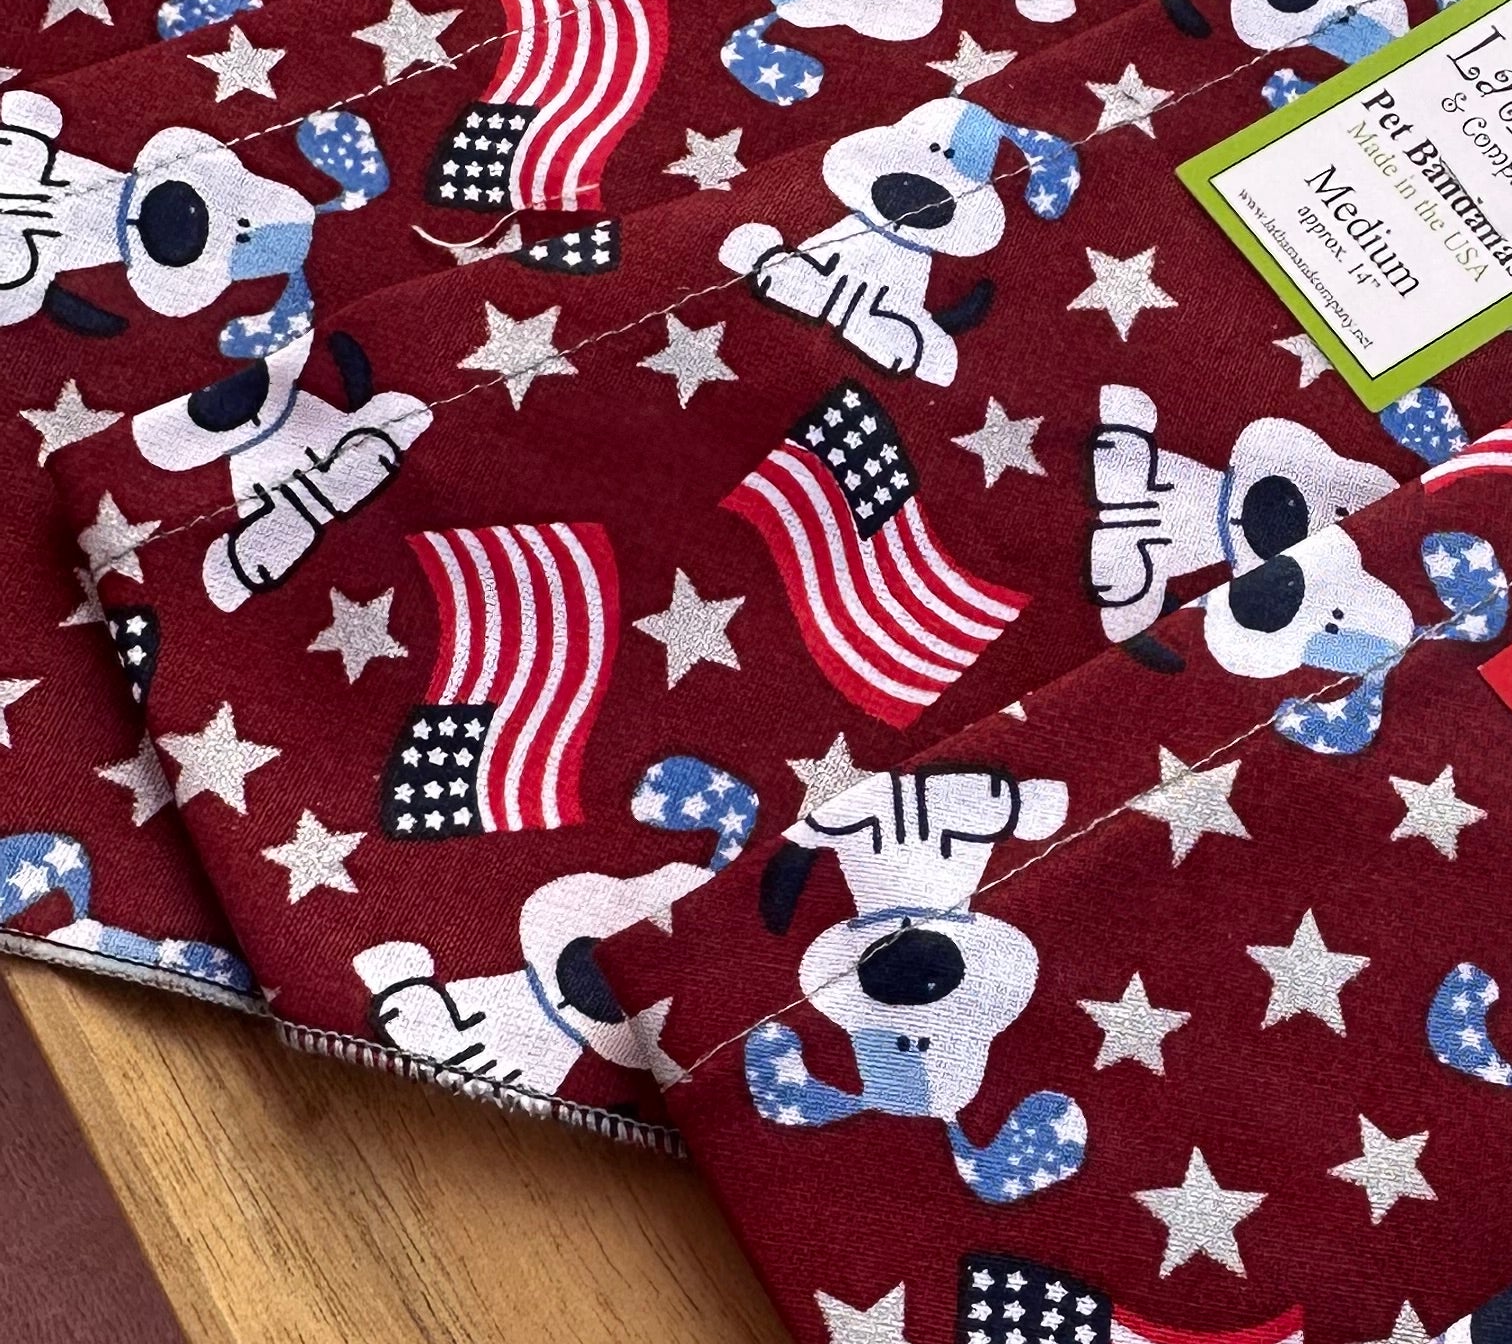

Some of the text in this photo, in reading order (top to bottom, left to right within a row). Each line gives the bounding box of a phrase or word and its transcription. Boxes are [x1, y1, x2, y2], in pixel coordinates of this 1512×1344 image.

[1360, 88, 1414, 143] Pet
[1440, 92, 1467, 116] &
[1346, 120, 1489, 284] Made in the USA
[1298, 206, 1347, 263] approx.
[1304, 164, 1419, 299] Medium
